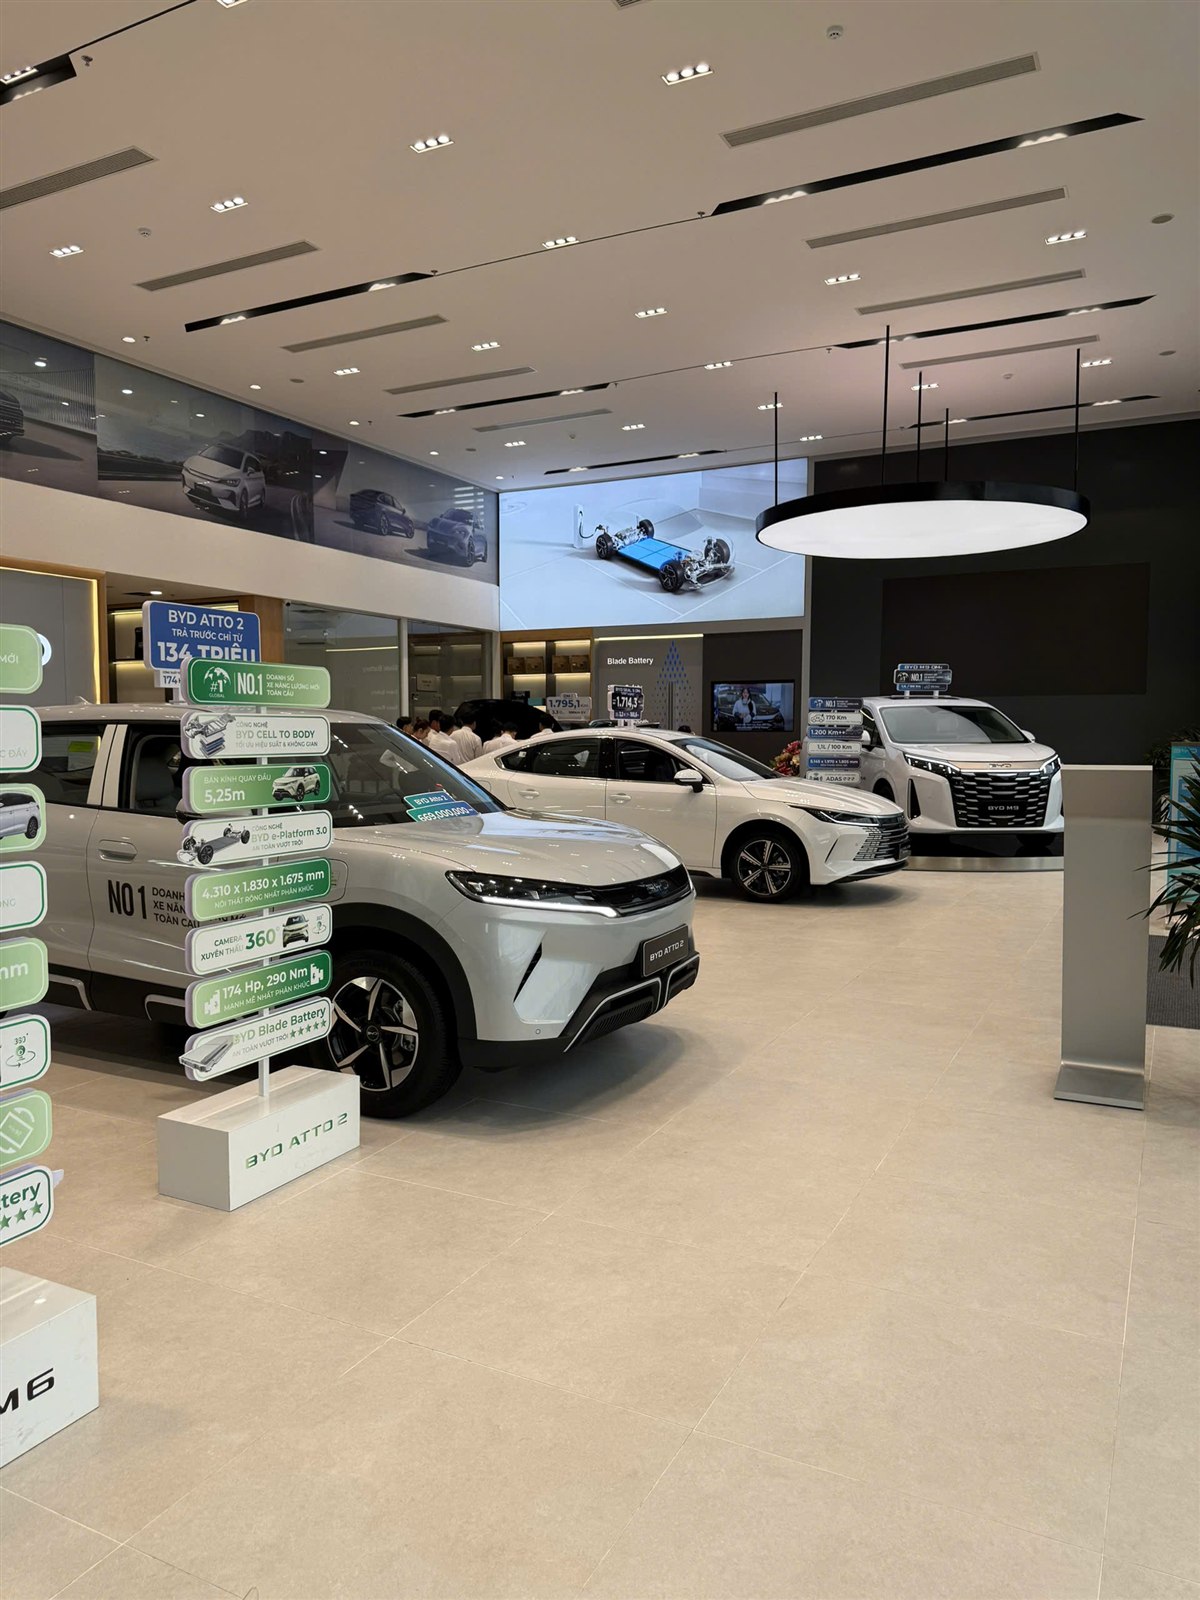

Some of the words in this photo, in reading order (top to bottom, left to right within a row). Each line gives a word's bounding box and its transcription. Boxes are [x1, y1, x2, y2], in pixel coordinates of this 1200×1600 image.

[168, 609, 196, 625] BYD
[200, 613, 234, 629] ATTO
[236, 617, 244, 630] 2
[171, 626, 188, 638] TRẢ
[157, 641, 192, 662] 134
[607, 657, 626, 665] Blade
[628, 656, 654, 666] Battery
[163, 675, 177, 685] 174
[237, 672, 263, 696] NO.1
[910, 673, 923, 681] NO.1
[549, 699, 580, 709] 1.795,1
[235, 730, 254, 739] BYD
[256, 730, 278, 739] CELL
[279, 730, 291, 739] TO
[292, 730, 315, 739] BODY
[238, 775, 257, 783] QUAY
[204, 788, 245, 805] 5,25m
[413, 797, 430, 805] BYD
[251, 832, 269, 843] BYD
[271, 828, 315, 841] e-Platform
[315, 826, 328, 835] 3.0
[202, 885, 231, 899] 4.310
[233, 884, 240, 894] x
[242, 878, 269, 893] 1.830
[271, 879, 278, 888] x
[280, 872, 304, 886] 1.675
[306, 870, 325, 881] mm
[152, 886, 185, 901] DOANH
[137, 885, 147, 920] 1
[153, 900, 165, 911] XE
[166, 902, 186, 914] NĂN
[153, 912, 179, 926] TOÀN
[214, 935, 243, 947] CAMERA
[650, 949, 663, 962] BYD
[663, 942, 679, 955] ATTO
[679, 939, 685, 947] 2
[222, 983, 242, 999] 174
[245, 979, 264, 993] Hp,
[266, 971, 287, 987] 290
[289, 967, 308, 981] Nm
[232, 1029, 256, 1046] BYD
[258, 1019, 288, 1037] Blade
[290, 1007, 326, 1026] Battery
[245, 1142, 283, 1170] BYD
[288, 1119, 333, 1149] ATTO
[337, 1112, 348, 1126] 2
[0, 1182, 41, 1209] tery
